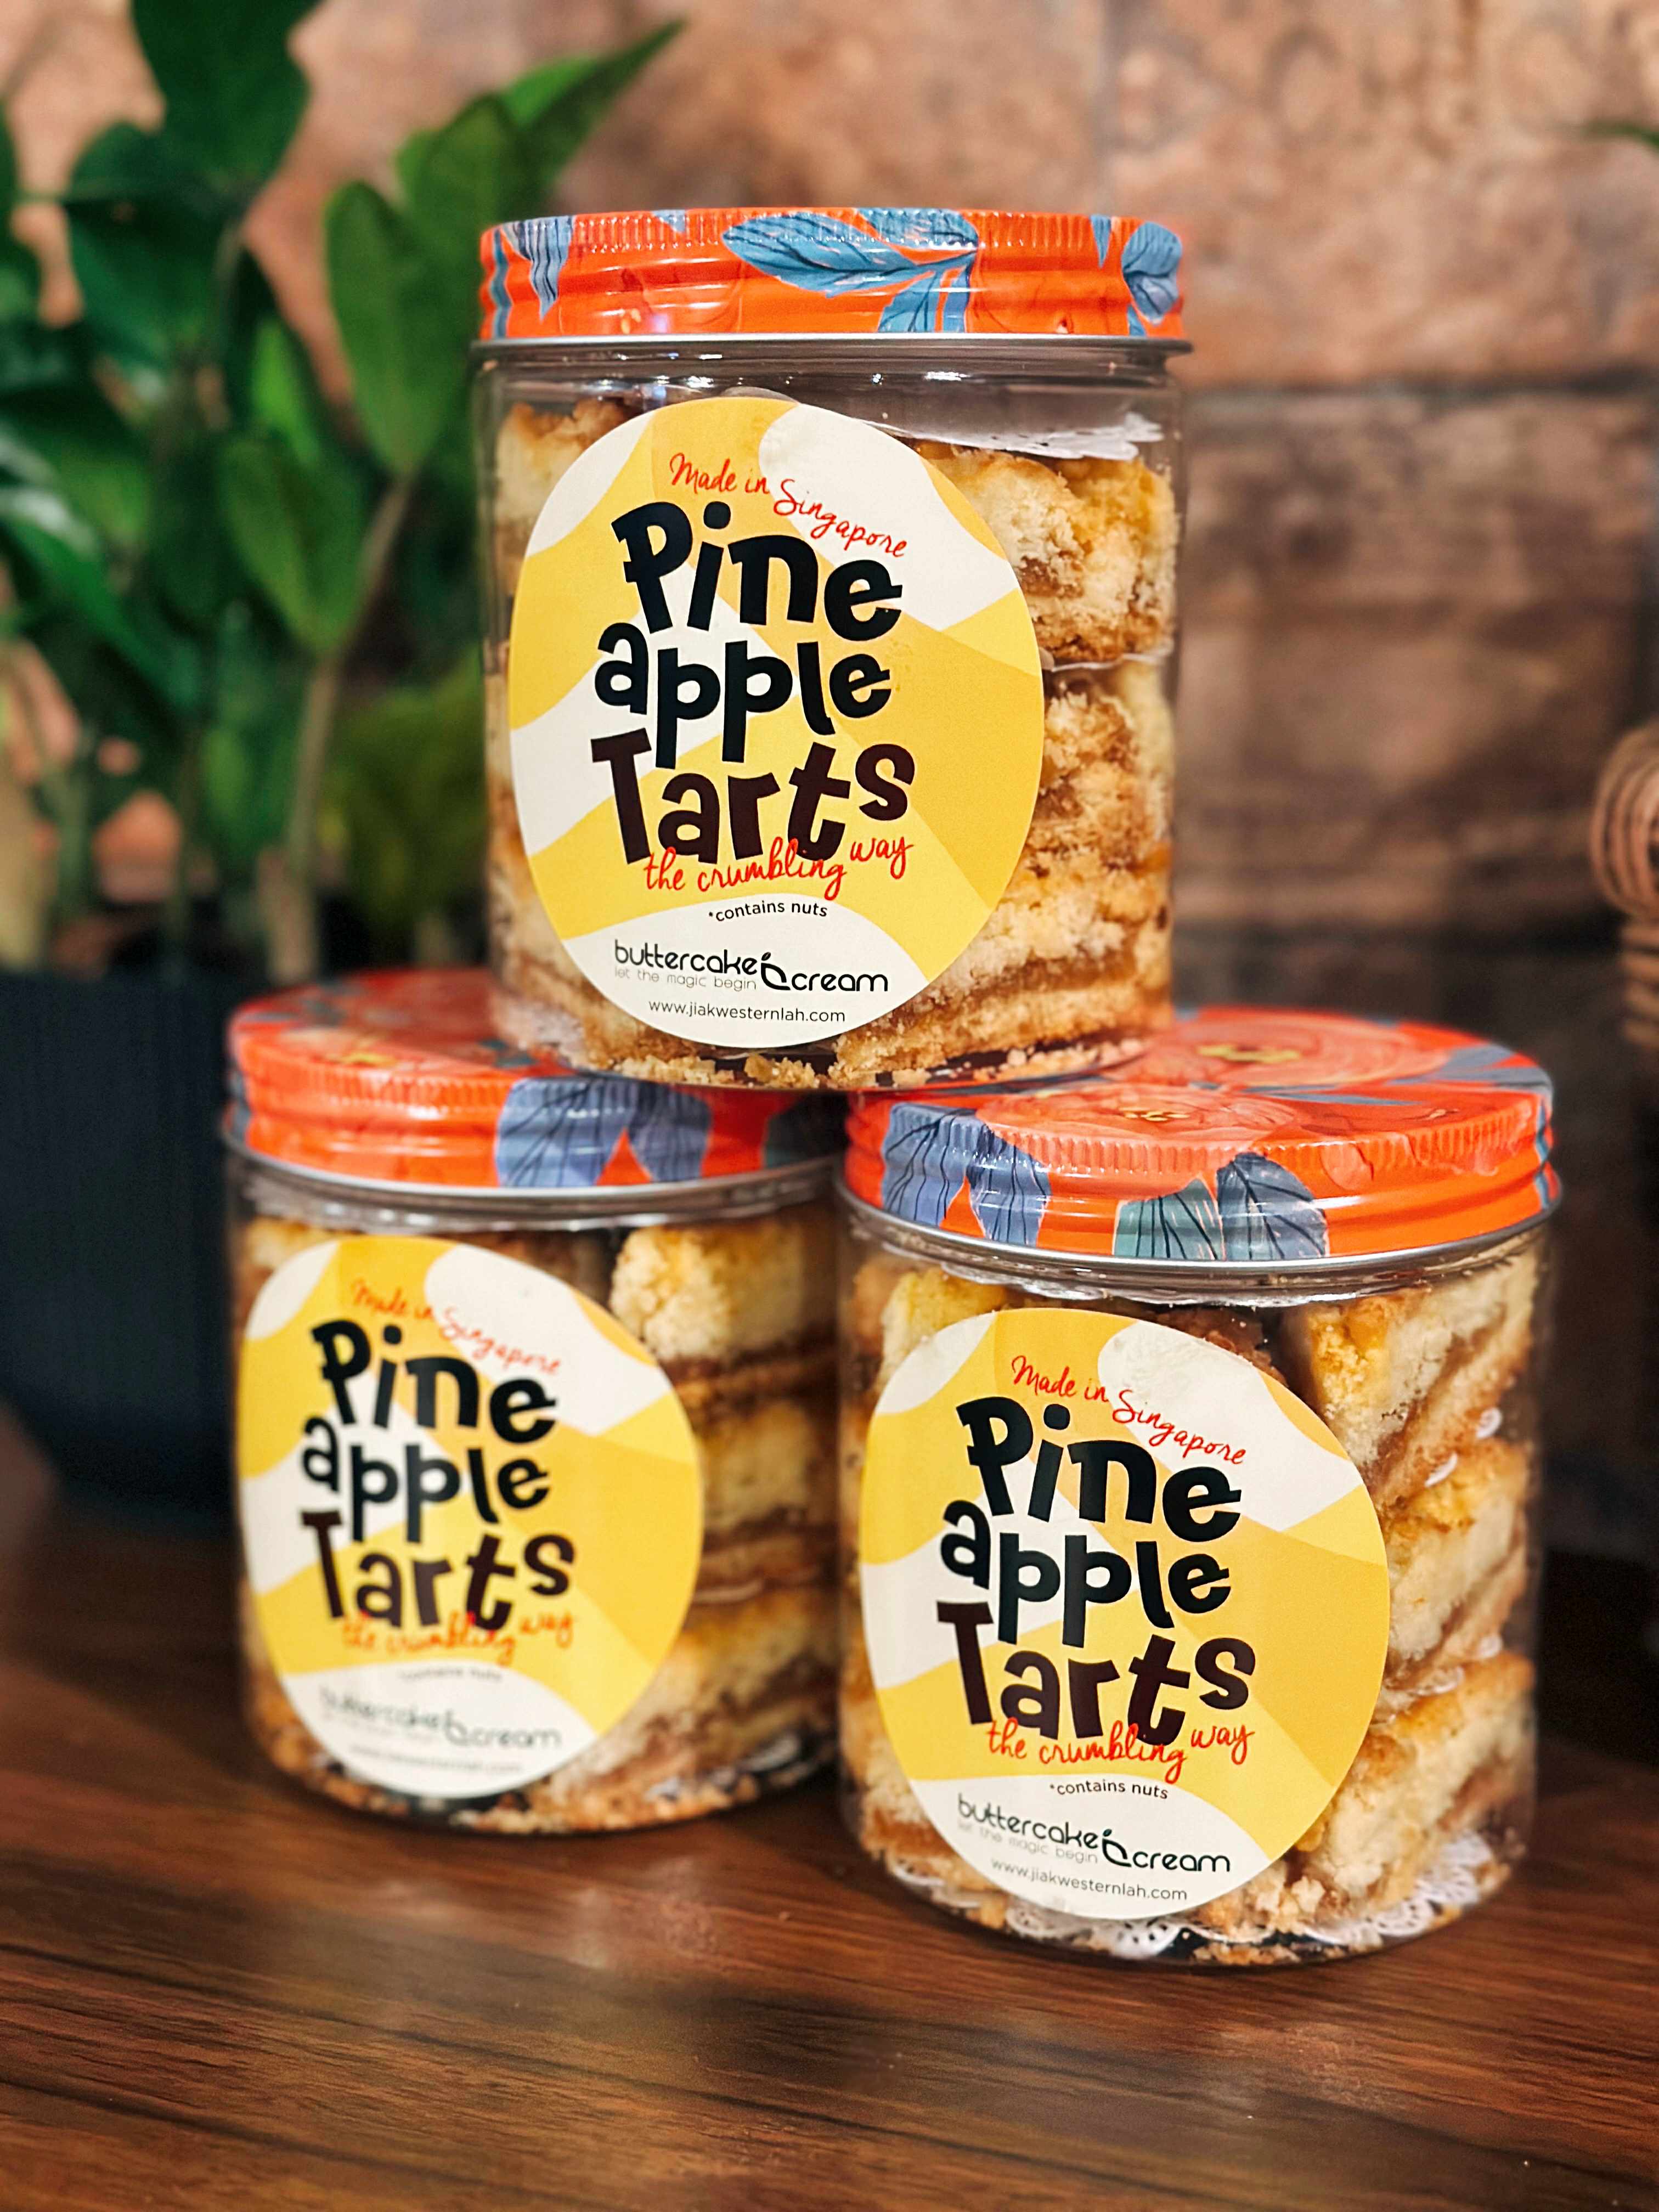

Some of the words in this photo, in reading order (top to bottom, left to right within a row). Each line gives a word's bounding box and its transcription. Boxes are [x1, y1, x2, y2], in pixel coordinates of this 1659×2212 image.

[669, 453, 737, 494] Made
[744, 467, 770, 494] in
[773, 478, 908, 558] Singapore
[611, 501, 903, 642] Pine
[594, 622, 891, 769] apple
[591, 728, 915, 866] Tarts
[643, 846, 685, 891] the
[697, 836, 848, 901] crumbling
[850, 836, 915, 879] way
[791, 901, 828, 918] nuts
[614, 939, 758, 975] buttercake
[791, 973, 889, 992] cream
[614, 966, 630, 978] let
[637, 967, 660, 984] the
[667, 973, 707, 988] magic
[714, 976, 757, 993] begin
[648, 998, 846, 1023] www.jiakwesternlah.com
[311, 1319, 557, 1444] Pine
[1012, 1355, 1078, 1397] Made
[1084, 1378, 1110, 1402] in
[1113, 1390, 1246, 1465] Singapore
[301, 1414, 550, 1543] apple
[955, 1395, 1242, 1543] Pine
[300, 1509, 576, 1632] Tarts
[940, 1498, 1232, 1648] apple
[936, 1600, 1256, 1747] Tarts
[986, 1717, 1026, 1760] the
[1041, 1720, 1187, 1785] crumbling
[1190, 1723, 1256, 1765] way
[1131, 1782, 1169, 1800] nuts
[958, 1793, 1098, 1849] buttercake
[1132, 1851, 1231, 1872] cream
[990, 1858, 1187, 1901] www.jiakwesternlah.com
[1008, 1836, 1048, 1856] magic
[1055, 1846, 1098, 1865] begin
